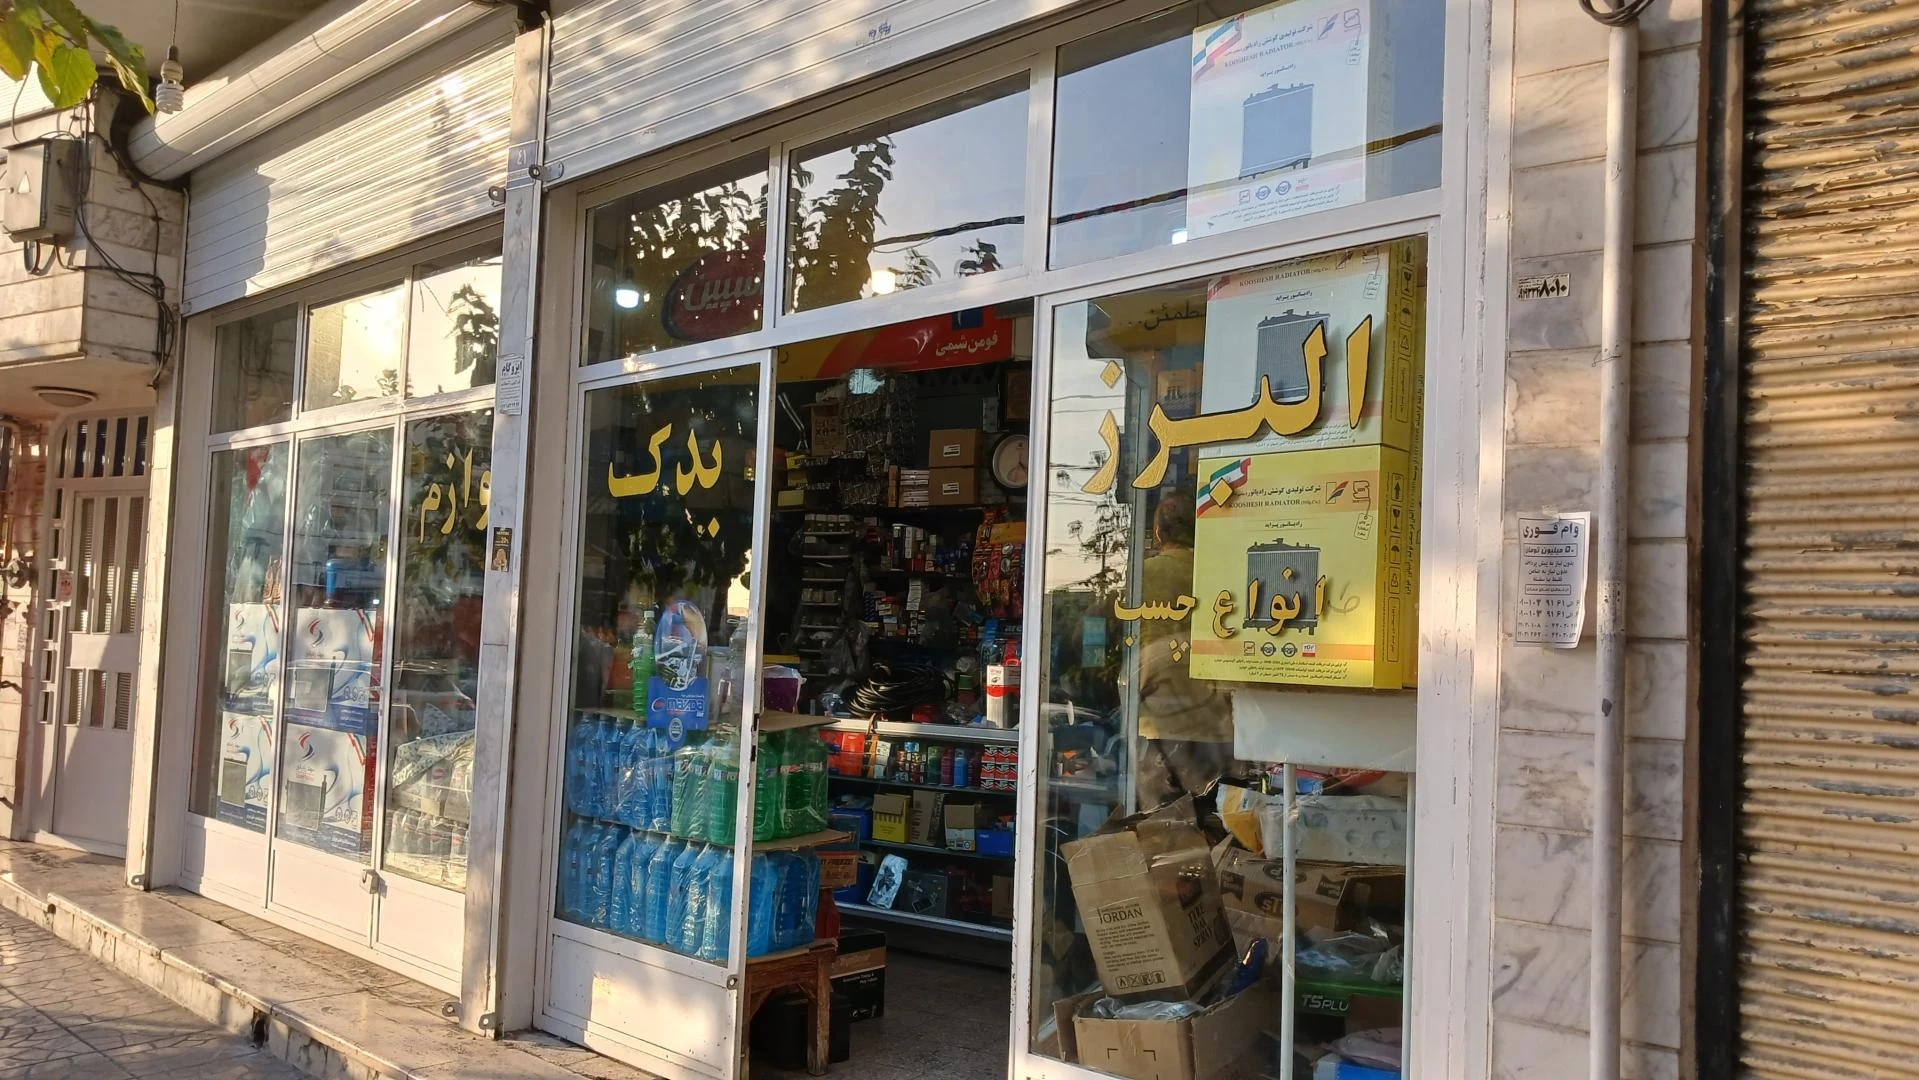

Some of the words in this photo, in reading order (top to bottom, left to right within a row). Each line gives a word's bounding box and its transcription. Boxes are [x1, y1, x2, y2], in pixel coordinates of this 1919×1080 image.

[1274, 268, 1311, 283] RADIATOR
[935, 334, 969, 357] شیمی
[968, 329, 999, 353] فومن
[1081, 314, 1372, 508] البرز
[1267, 486, 1285, 496] کوشش
[1286, 485, 1304, 496] تولیدی
[1304, 484, 1321, 493] شرکت
[1264, 499, 1301, 508] RADIATOR
[1522, 522, 1559, 539] فوری
[1560, 523, 1579, 540] وام
[1540, 546, 1564, 557] میلیون
[1564, 545, 1575, 554] ۵۰
[1212, 566, 1328, 639] انواع
[1113, 592, 1198, 663] چسب
[1097, 906, 1143, 924] JORDAN
